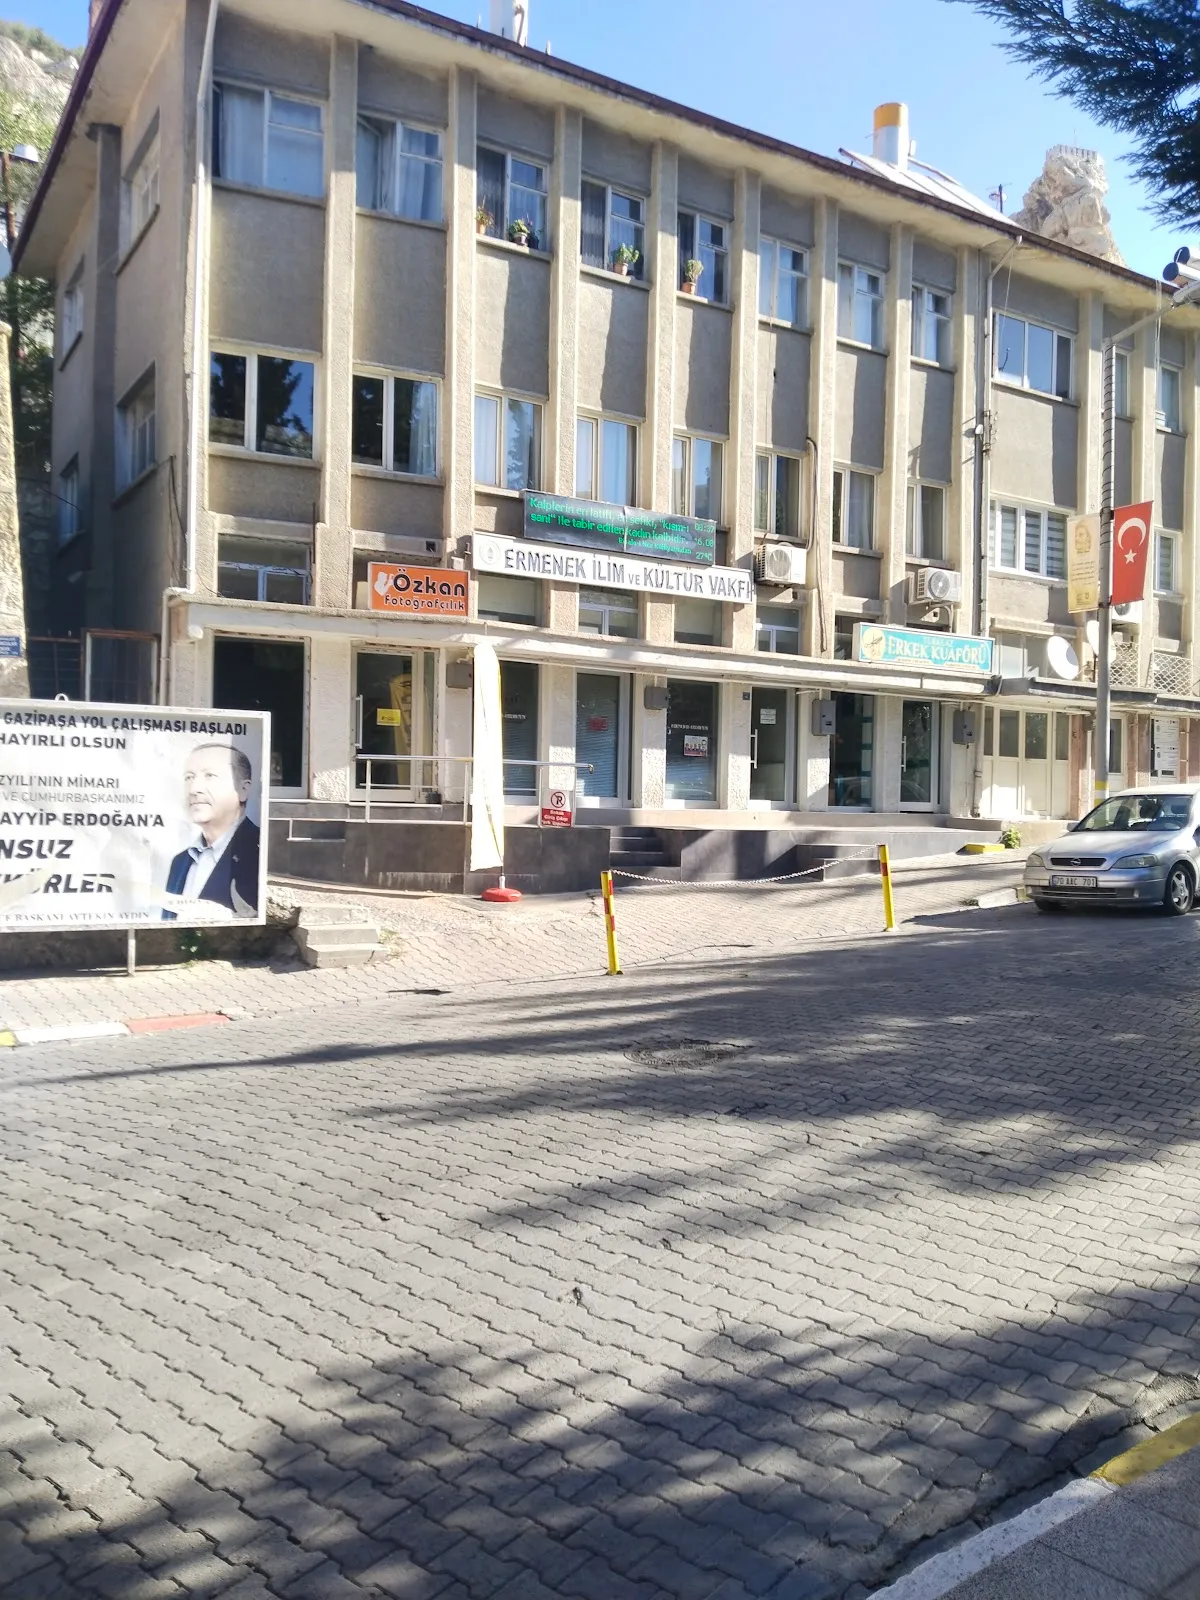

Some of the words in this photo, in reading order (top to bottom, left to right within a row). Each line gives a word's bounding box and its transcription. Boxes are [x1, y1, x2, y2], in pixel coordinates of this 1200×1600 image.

[393, 568, 465, 596] Özkan
[504, 548, 587, 579] ERMENEK
[592, 553, 625, 584] İLİM
[643, 563, 704, 594] KÜLTÜR
[888, 635, 927, 658] ERKEK
[931, 644, 986, 665] KUAFÖRÜ
[3, 709, 77, 730] GAZİPAŞA
[81, 715, 108, 729] YOL
[111, 716, 187, 734] ÇALIŞMASI
[190, 721, 247, 737] BAŞLADI
[70, 735, 127, 750] OLSUN
[67, 773, 120, 789] MİMARI
[2, 791, 18, 802] VE
[62, 809, 165, 827] ERDOĞAN'A
